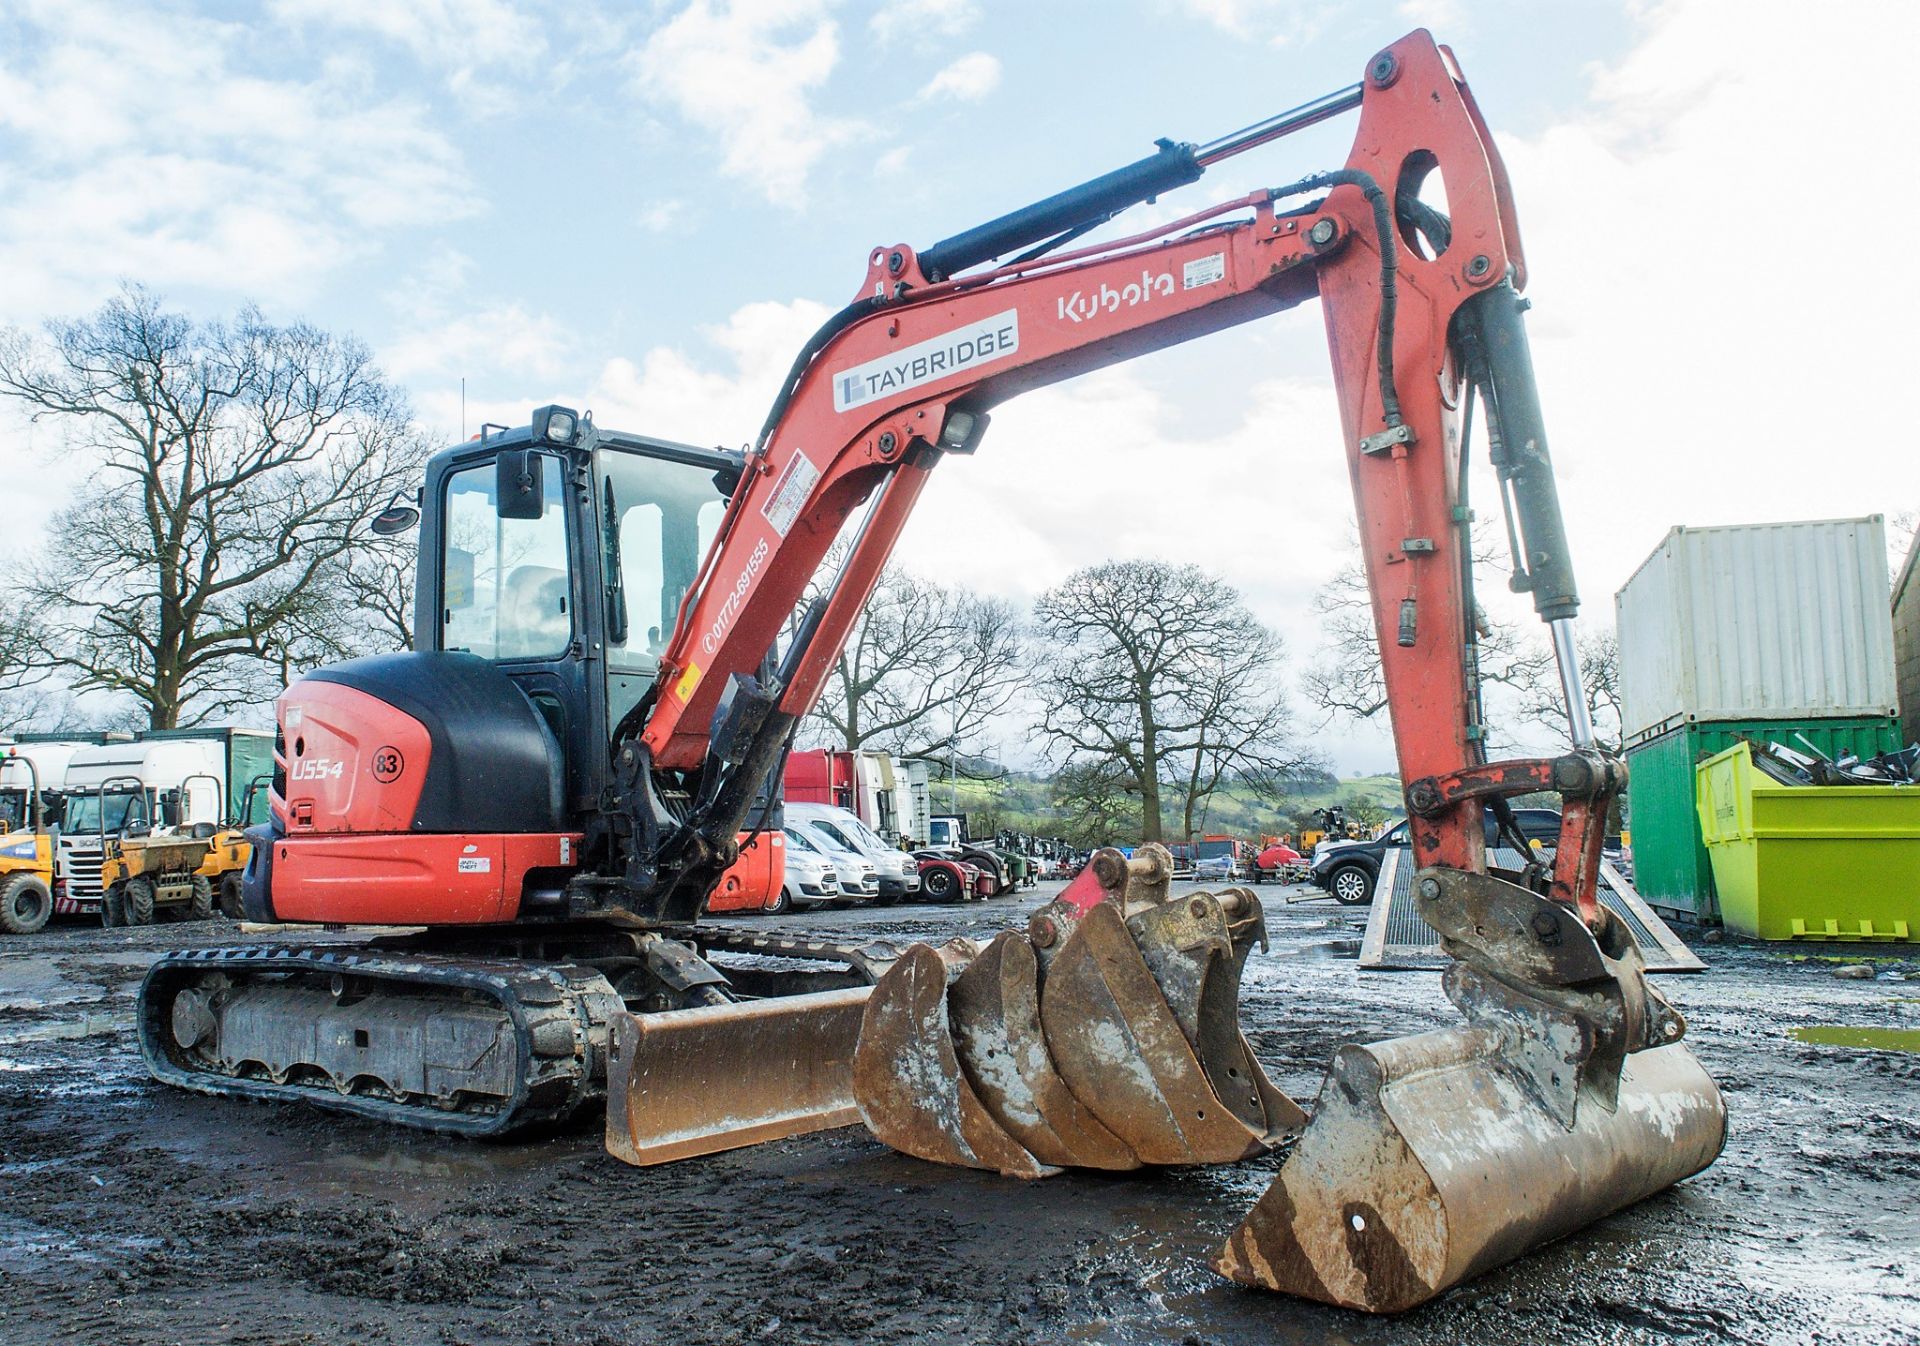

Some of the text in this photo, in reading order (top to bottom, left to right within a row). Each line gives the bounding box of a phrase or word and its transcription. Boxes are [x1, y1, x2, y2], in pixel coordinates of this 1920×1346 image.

[1058, 270, 1175, 323] Kubota
[866, 326, 1014, 394] TAYBRIDGE
[713, 537, 769, 639] 01772-691555
[376, 754, 398, 773] 83
